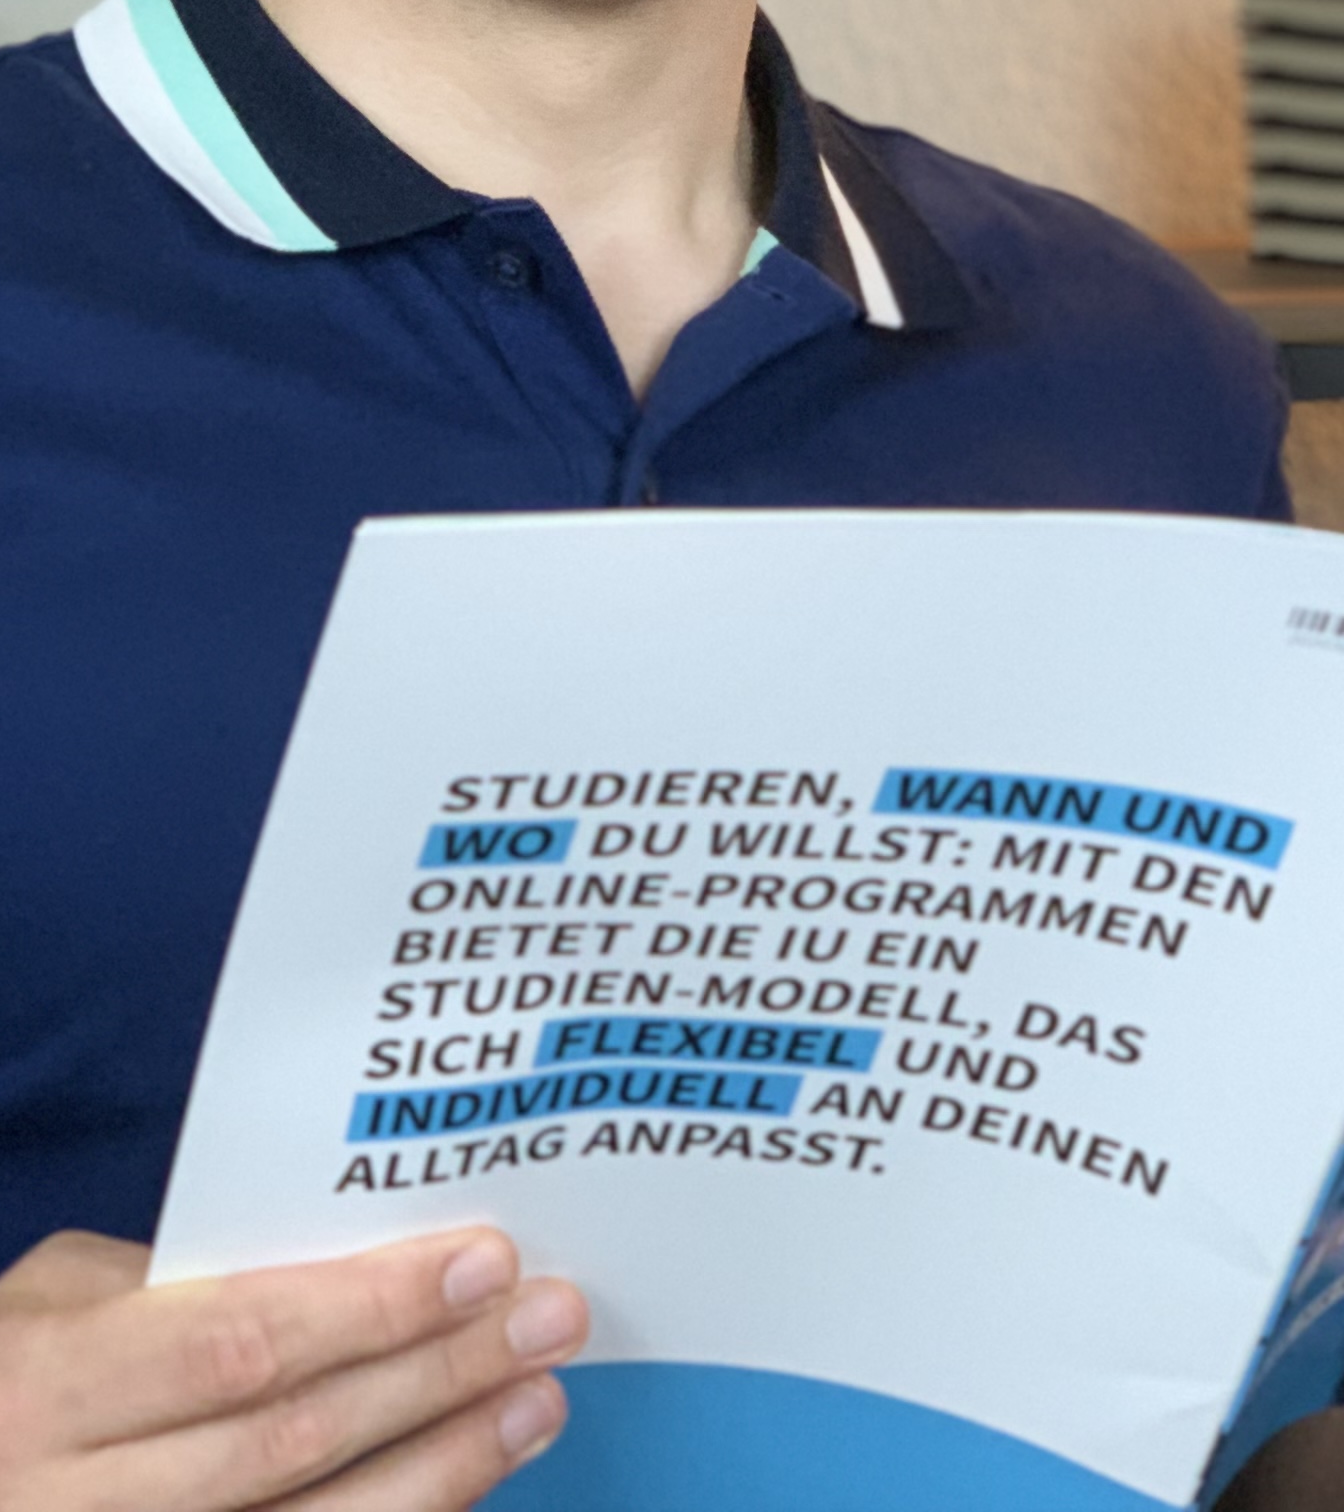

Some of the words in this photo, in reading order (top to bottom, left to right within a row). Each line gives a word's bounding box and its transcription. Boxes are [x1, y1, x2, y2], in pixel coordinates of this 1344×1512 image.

[442, 770, 854, 814] STUDIEREN,
[897, 773, 1105, 826] WANN
[1122, 793, 1271, 856] UND
[408, 872, 1189, 958] ONLINE-PROGRAMMEN
[442, 823, 556, 865] WO
[589, 822, 689, 859] DU
[708, 822, 972, 867] WILLST:
[991, 834, 1117, 882] MIT
[1132, 853, 1274, 922] DEN
[392, 922, 631, 966] BIETET
[647, 922, 759, 960] DIE
[776, 926, 849, 964] IU
[865, 930, 980, 975] EIN
[365, 1030, 521, 1081] SICH
[552, 1019, 855, 1068] FLEXIBEL
[895, 1037, 1039, 1093] UND
[378, 970, 991, 1037] STUDIEN-MODELL,
[1014, 1002, 1144, 1065] DAS
[335, 1124, 566, 1193] ALLTAG
[580, 1120, 884, 1176] ANPASST.
[366, 1070, 775, 1137] INDIVIDUELL
[809, 1082, 905, 1124] AN
[920, 1094, 1169, 1197] DEINEN
